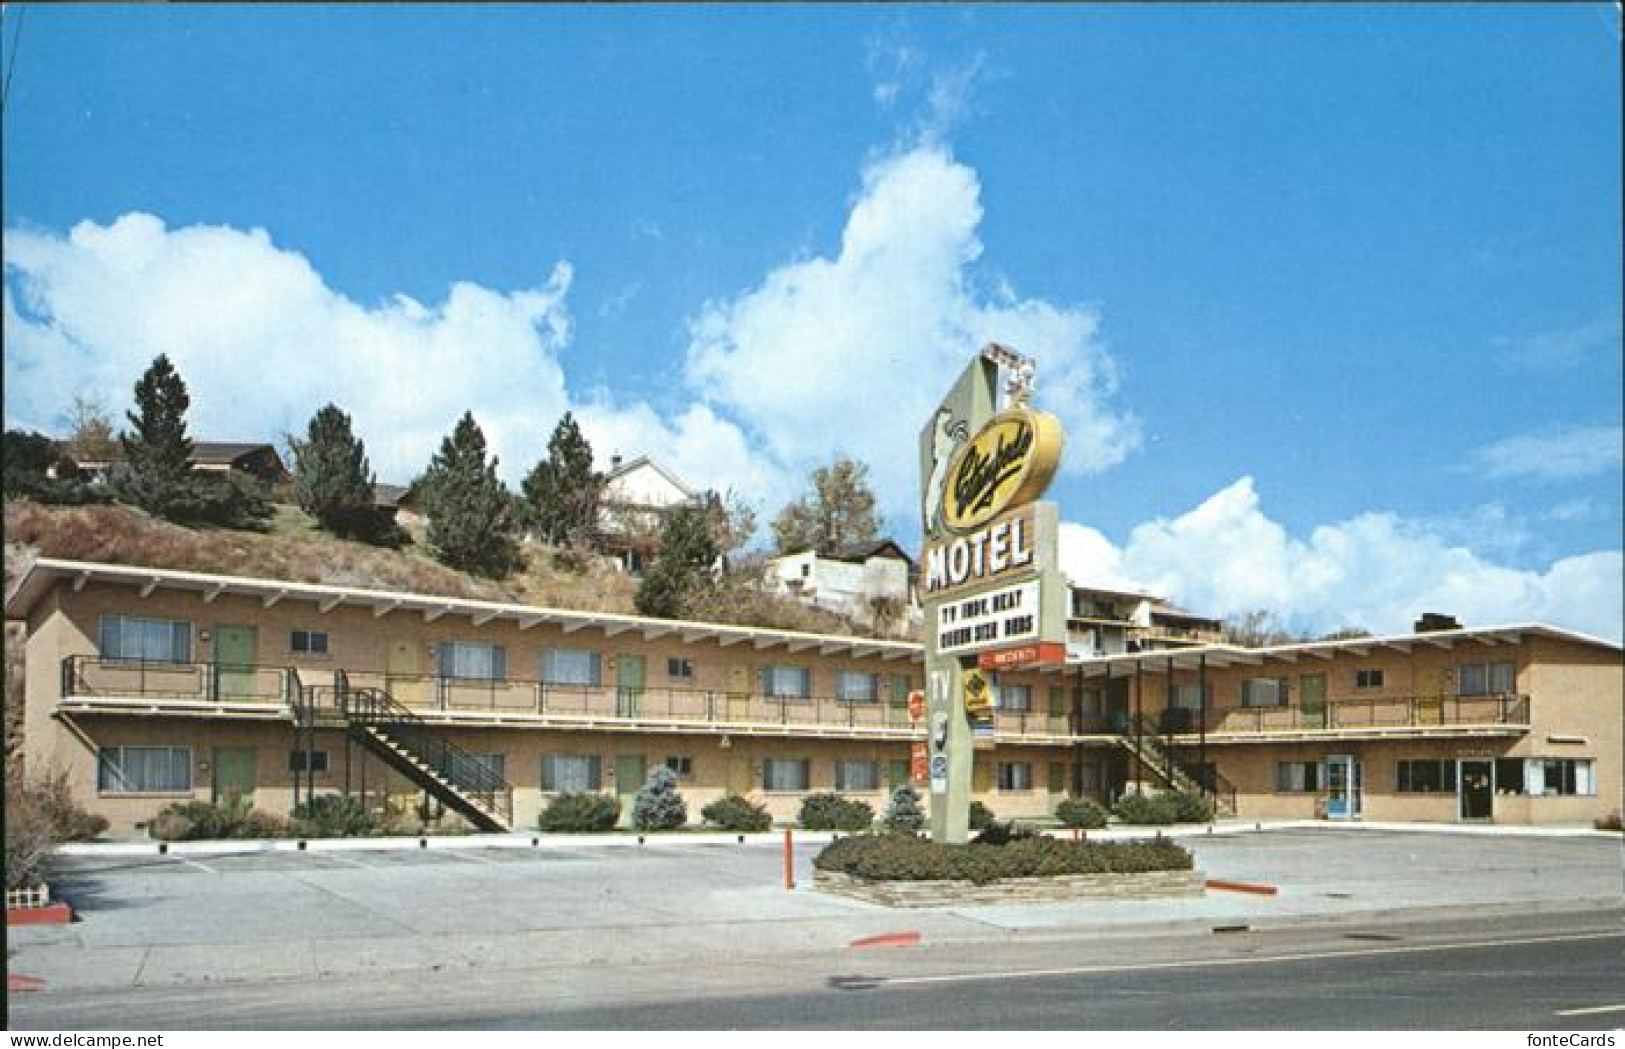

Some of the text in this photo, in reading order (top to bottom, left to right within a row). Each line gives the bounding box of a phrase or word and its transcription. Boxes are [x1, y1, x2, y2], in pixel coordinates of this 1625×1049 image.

[926, 518, 1033, 592] MOTEL
[941, 606, 957, 624] TV
[992, 589, 1022, 613] HEAT
[1004, 614, 1033, 636] BEDS
[930, 669, 950, 700] TV
